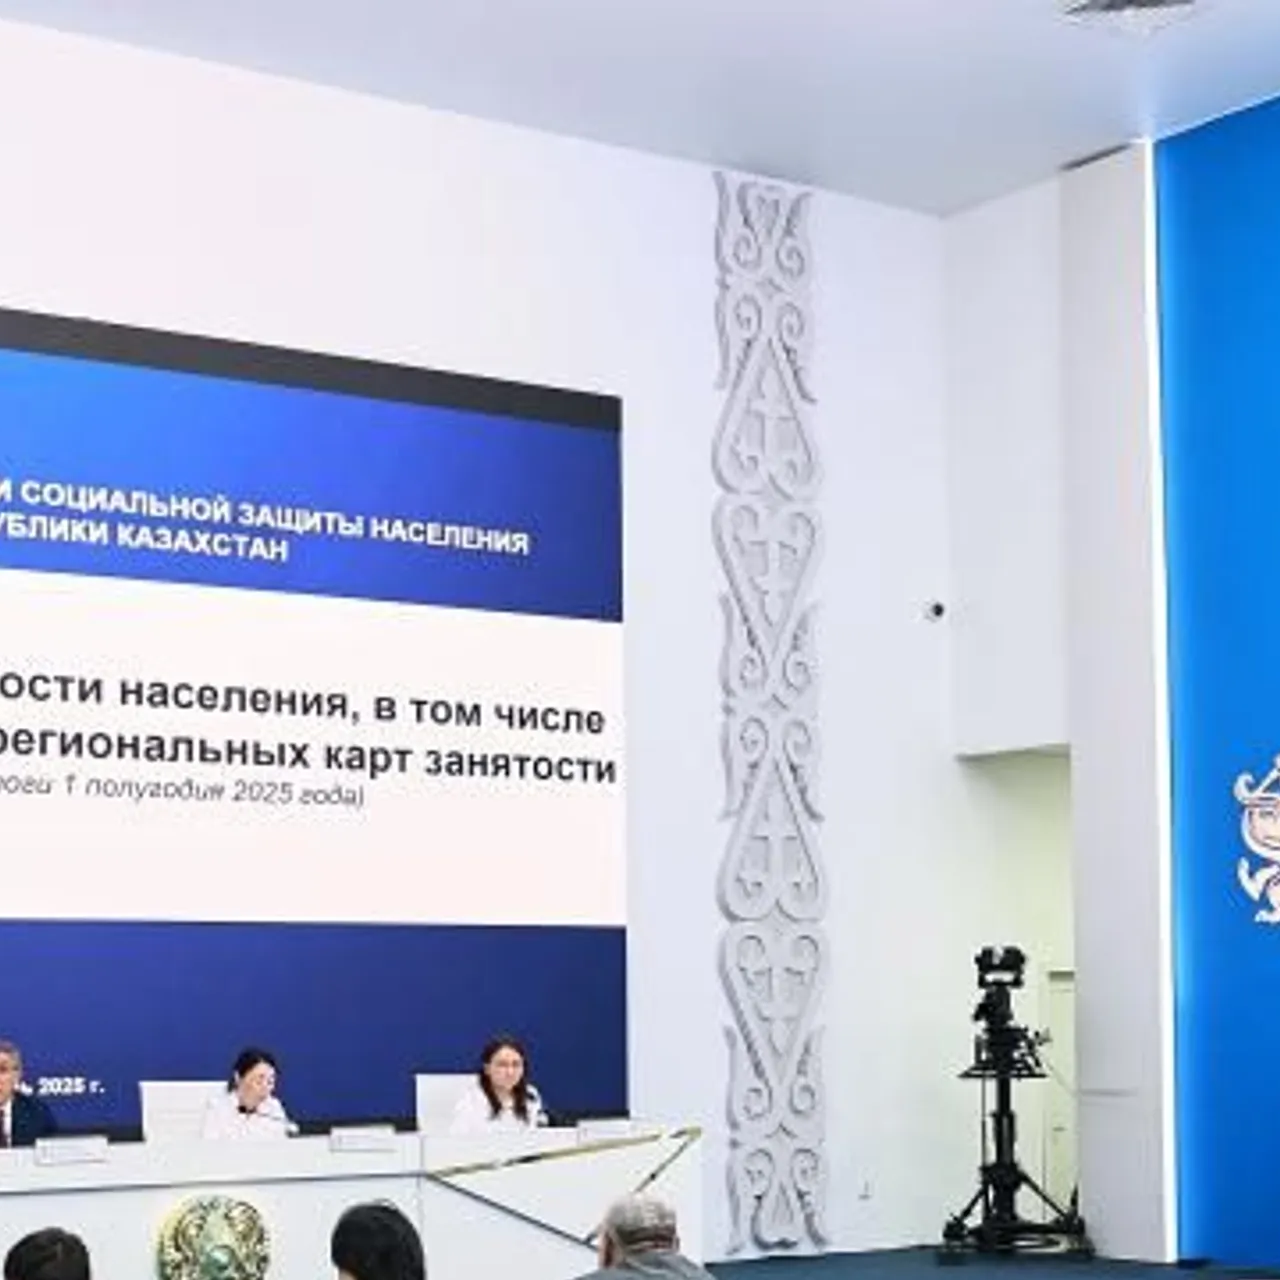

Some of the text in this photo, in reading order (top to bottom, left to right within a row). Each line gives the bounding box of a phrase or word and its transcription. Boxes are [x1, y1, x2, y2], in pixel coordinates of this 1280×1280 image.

[21, 480, 231, 524] СОЦИАЛЬНОЙ
[238, 503, 364, 538] ЗАЩИТЫ
[371, 516, 530, 556] НАСЕЛЕНИЯ
[117, 522, 290, 563] КАЗАХСТАН
[119, 678, 361, 725] населения,
[374, 696, 398, 722] в
[408, 697, 483, 728] том
[494, 703, 606, 735] числе
[324, 742, 414, 779] карт
[424, 750, 617, 785] занятости
[65, 774, 76, 795] 1
[85, 778, 226, 804] полугодия
[232, 778, 294, 805] 2025
[298, 783, 365, 810] года)
[38, 1076, 87, 1096] 2025
